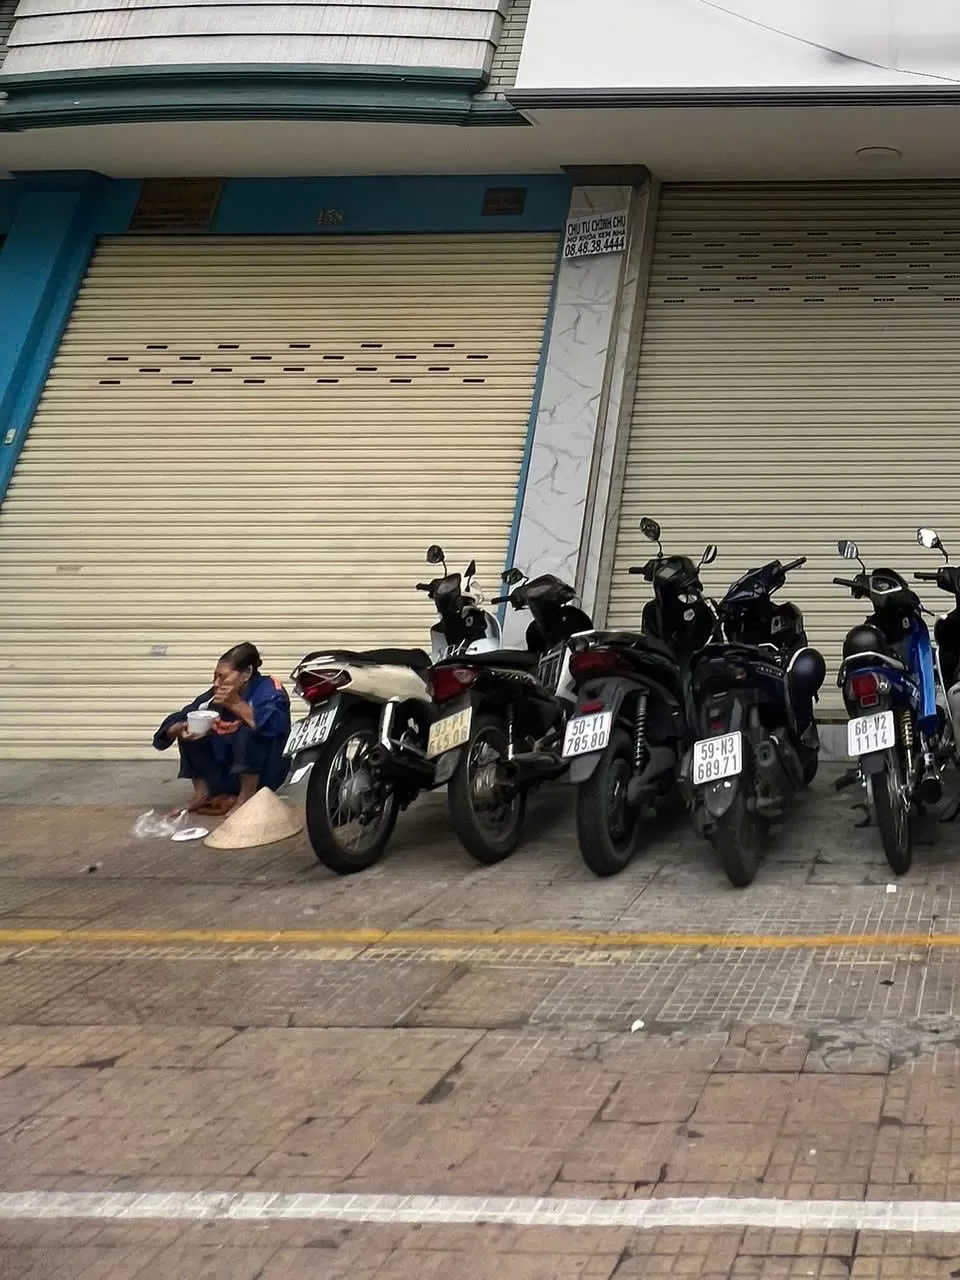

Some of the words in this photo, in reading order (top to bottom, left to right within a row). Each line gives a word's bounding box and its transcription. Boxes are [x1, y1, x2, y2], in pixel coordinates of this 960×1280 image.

[565, 236, 625, 257] 08.48.38.4444
[572, 715, 605, 736] 50-Y1
[855, 715, 887, 735] 68-V2
[567, 731, 606, 756] 785.80
[701, 737, 735, 761] 59-N3
[856, 730, 888, 753] 1114
[697, 754, 738, 780] 689.71
